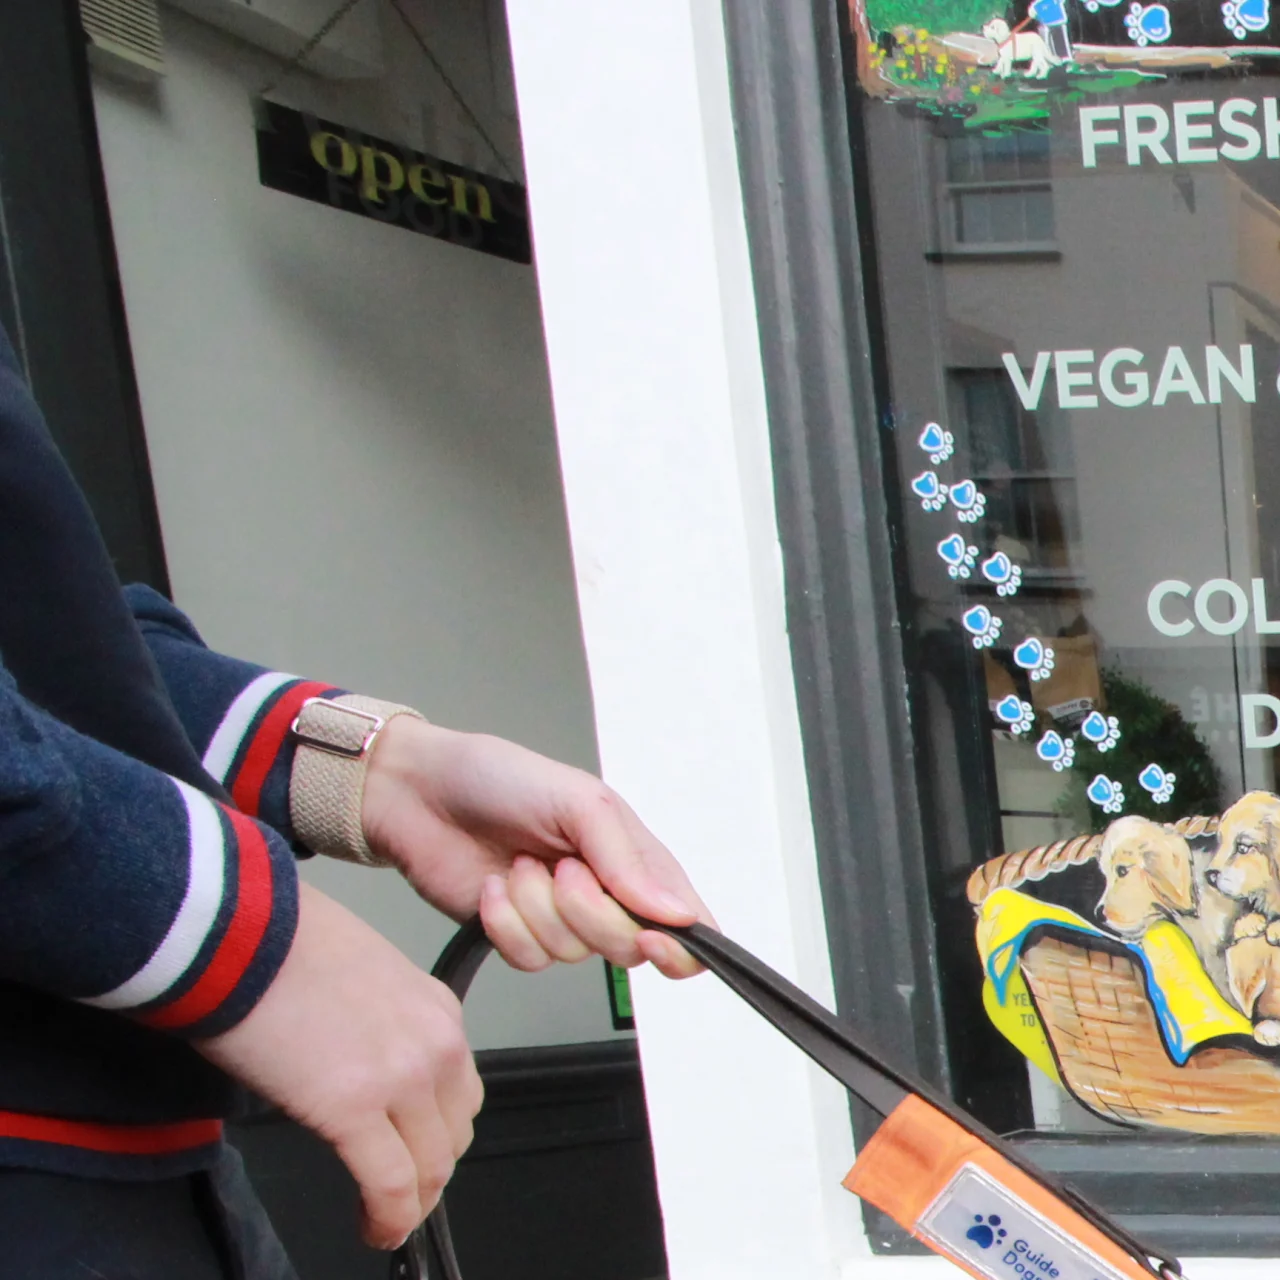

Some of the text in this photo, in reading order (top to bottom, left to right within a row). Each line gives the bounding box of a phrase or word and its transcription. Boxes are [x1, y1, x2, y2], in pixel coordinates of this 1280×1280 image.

[310, 131, 497, 223] open
[1002, 344, 1256, 411] VEGAN
[1011, 1237, 1061, 1280] Guide
